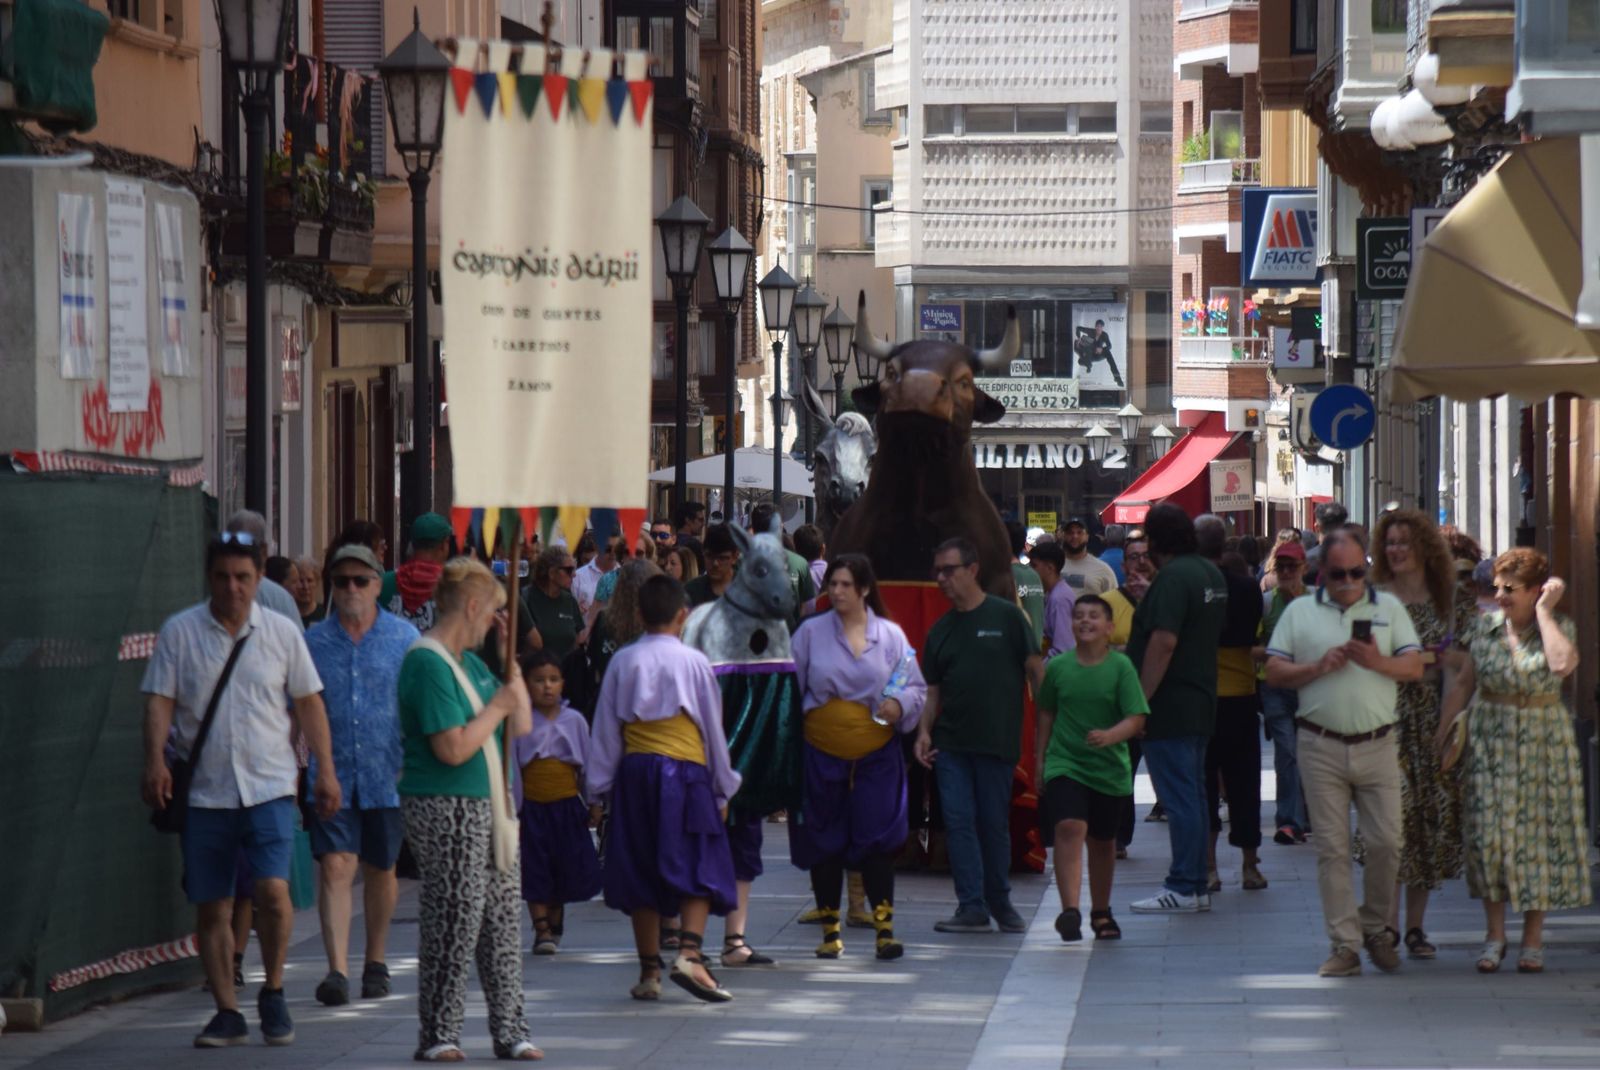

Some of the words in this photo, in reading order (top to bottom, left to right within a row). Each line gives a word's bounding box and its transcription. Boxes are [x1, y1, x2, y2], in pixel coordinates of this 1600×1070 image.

[1263, 251, 1312, 265] FIATC
[1011, 362, 1032, 373] VENDO
[992, 383, 1023, 392] EDIFICIO
[1023, 396, 1038, 408] 16
[1042, 396, 1057, 408] 92
[1061, 397, 1077, 409] 92
[1102, 445, 1128, 469] 2
